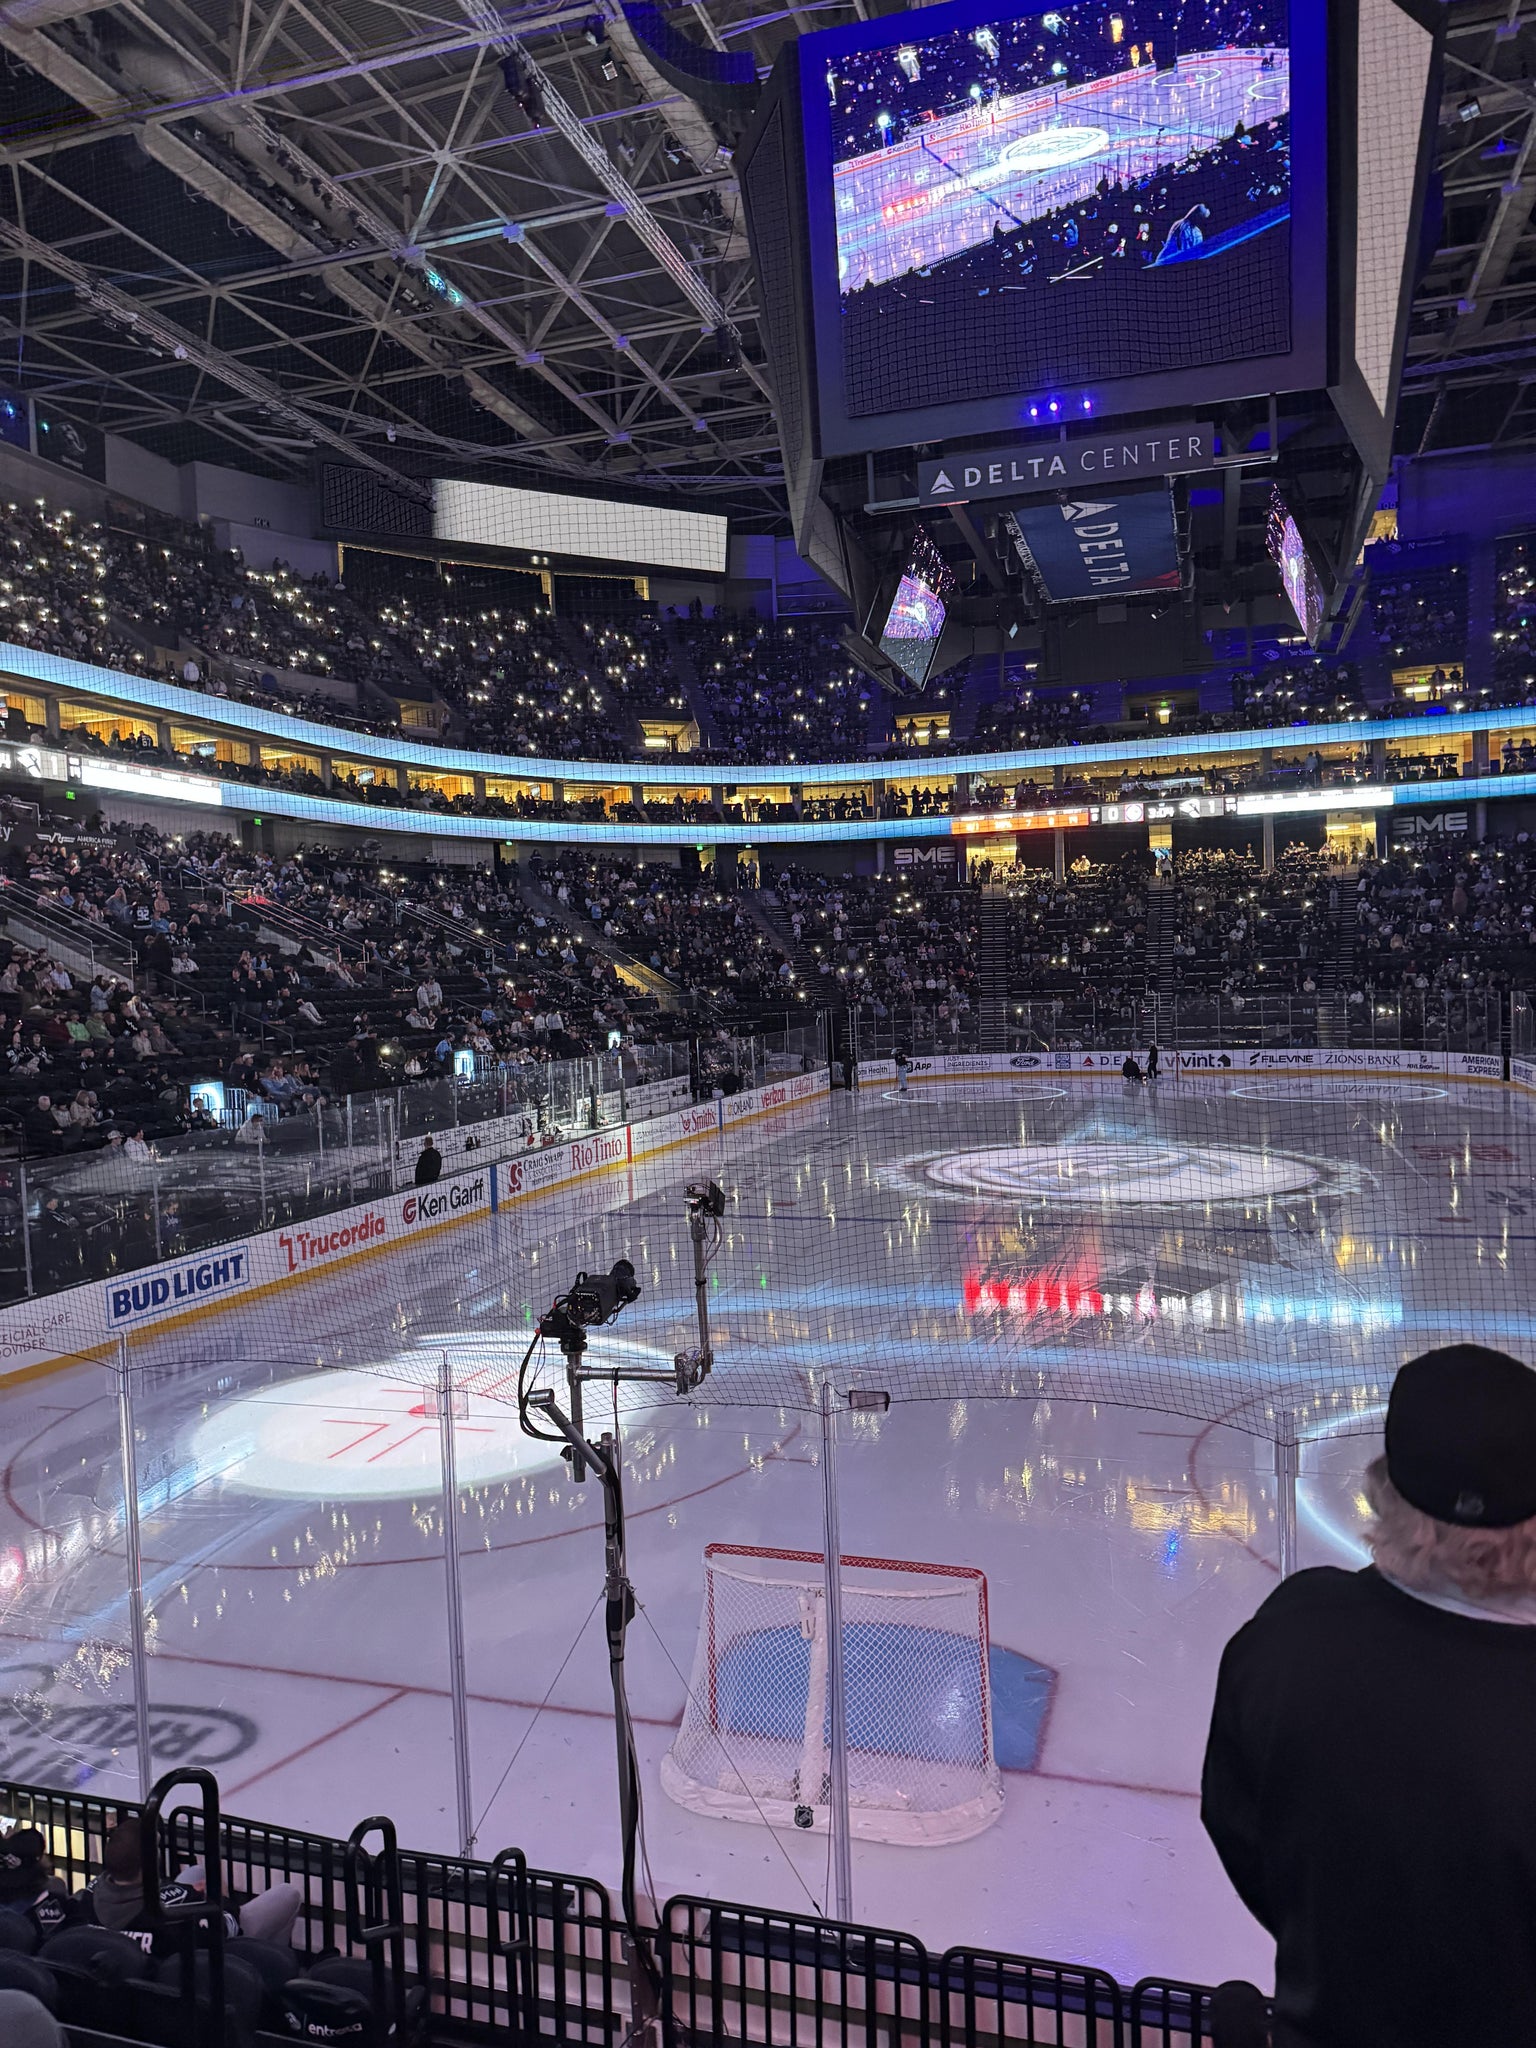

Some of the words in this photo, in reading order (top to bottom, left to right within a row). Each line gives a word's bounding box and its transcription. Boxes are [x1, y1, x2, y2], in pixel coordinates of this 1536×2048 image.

[964, 456, 1066, 488] DELTA
[1081, 437, 1203, 471] CENTER
[1073, 522, 1132, 586] DELTA
[1393, 812, 1468, 835] SME
[894, 846, 956, 865] SME
[1100, 1055, 1150, 1066] DET
[1325, 1054, 1363, 1064] ZIONS
[1367, 1054, 1400, 1065] BANK
[1461, 1055, 1500, 1066] AMERICAN
[1467, 1065, 1500, 1077] EXPRESS
[761, 1086, 786, 1108] verizon
[523, 1156, 544, 1172] CRAIG
[571, 1144, 592, 1171] Rio
[592, 1137, 623, 1163] Tinto
[418, 1192, 448, 1222] Ken
[450, 1178, 484, 1210] Garff
[297, 1212, 386, 1261] Trucordia
[112, 1278, 170, 1319] BUD
[173, 1253, 244, 1299] LIGHT
[0, 1321, 41, 1344] FICIAL
[42, 1311, 73, 1334] CARE
